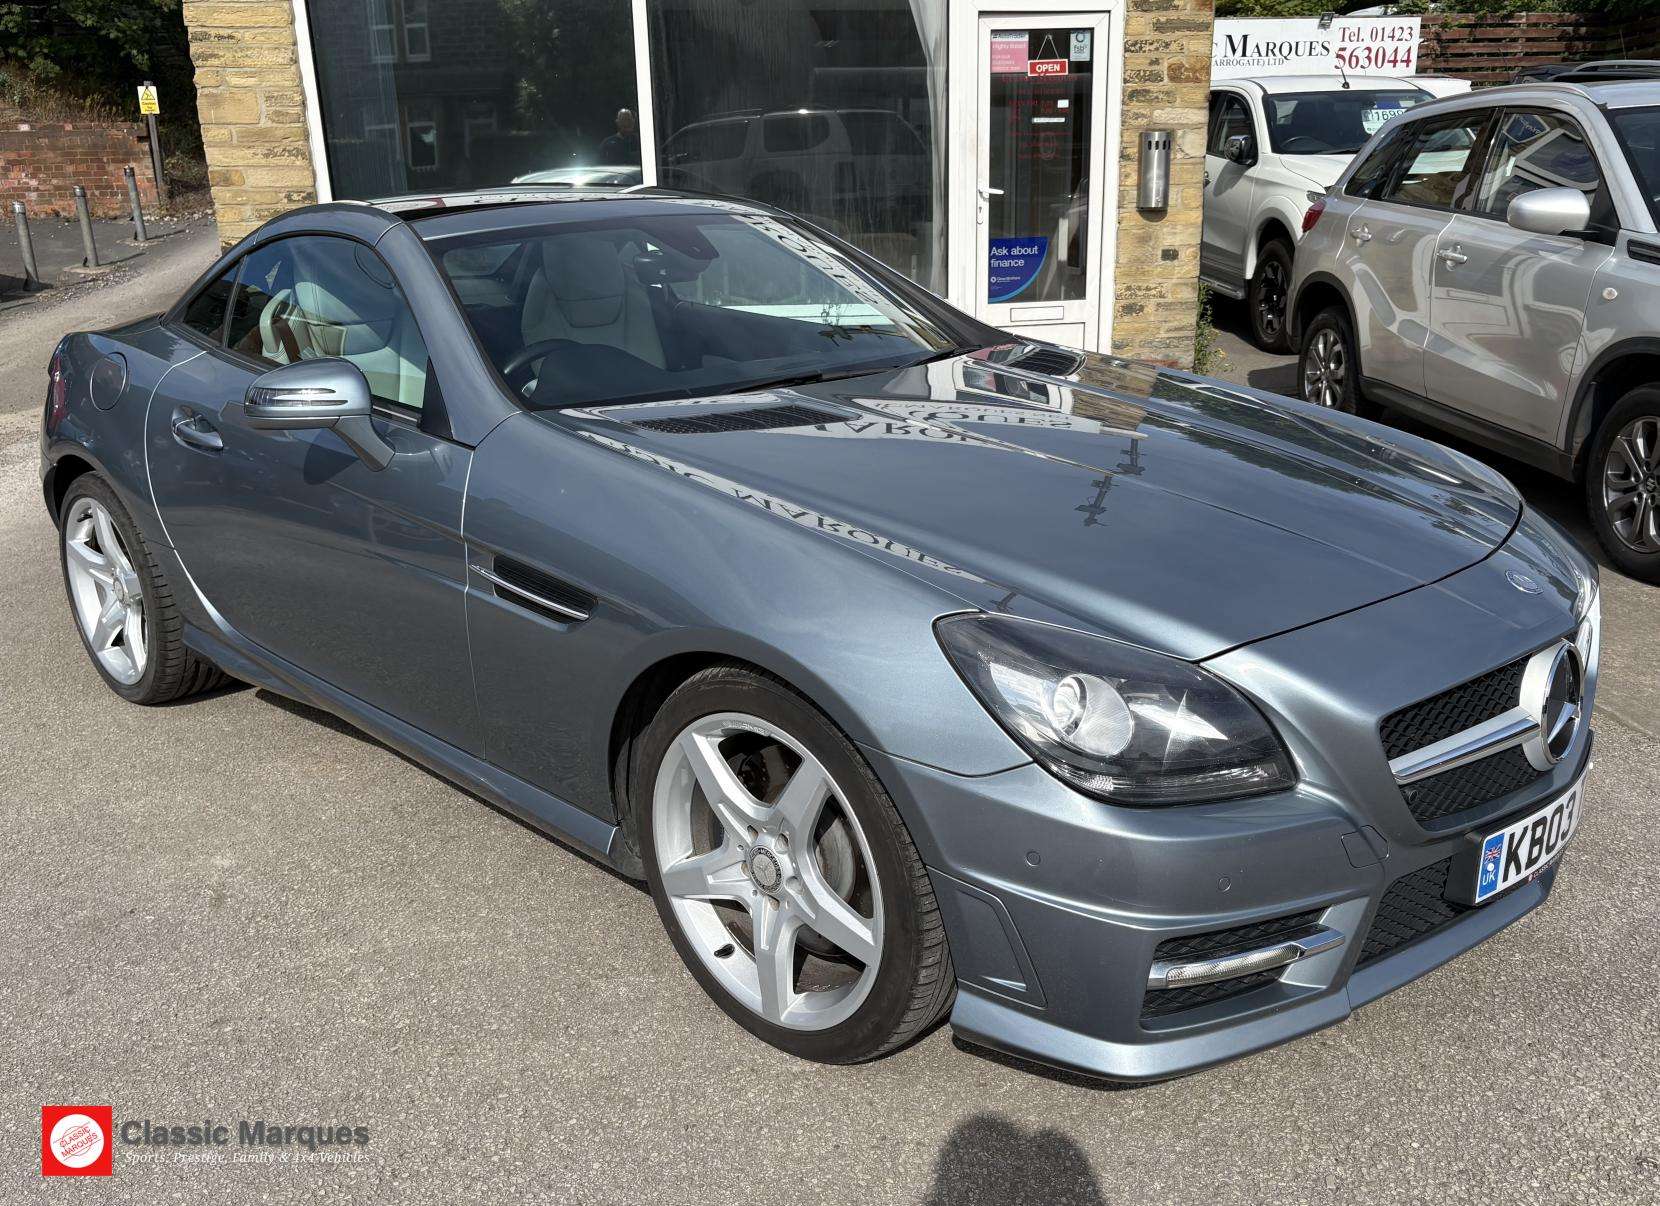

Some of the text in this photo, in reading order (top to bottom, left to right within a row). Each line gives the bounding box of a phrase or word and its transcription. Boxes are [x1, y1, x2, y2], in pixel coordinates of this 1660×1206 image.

[1338, 26, 1414, 43] Tel. 01423
[1267, 57, 1285, 66] LTD
[1334, 46, 1412, 70] 563044
[1035, 63, 1060, 73] OPEN
[990, 245, 1039, 256] Ask about
[990, 259, 1025, 268] finance
[1502, 790, 1577, 883] KB03
[1482, 869, 1497, 885] UK
